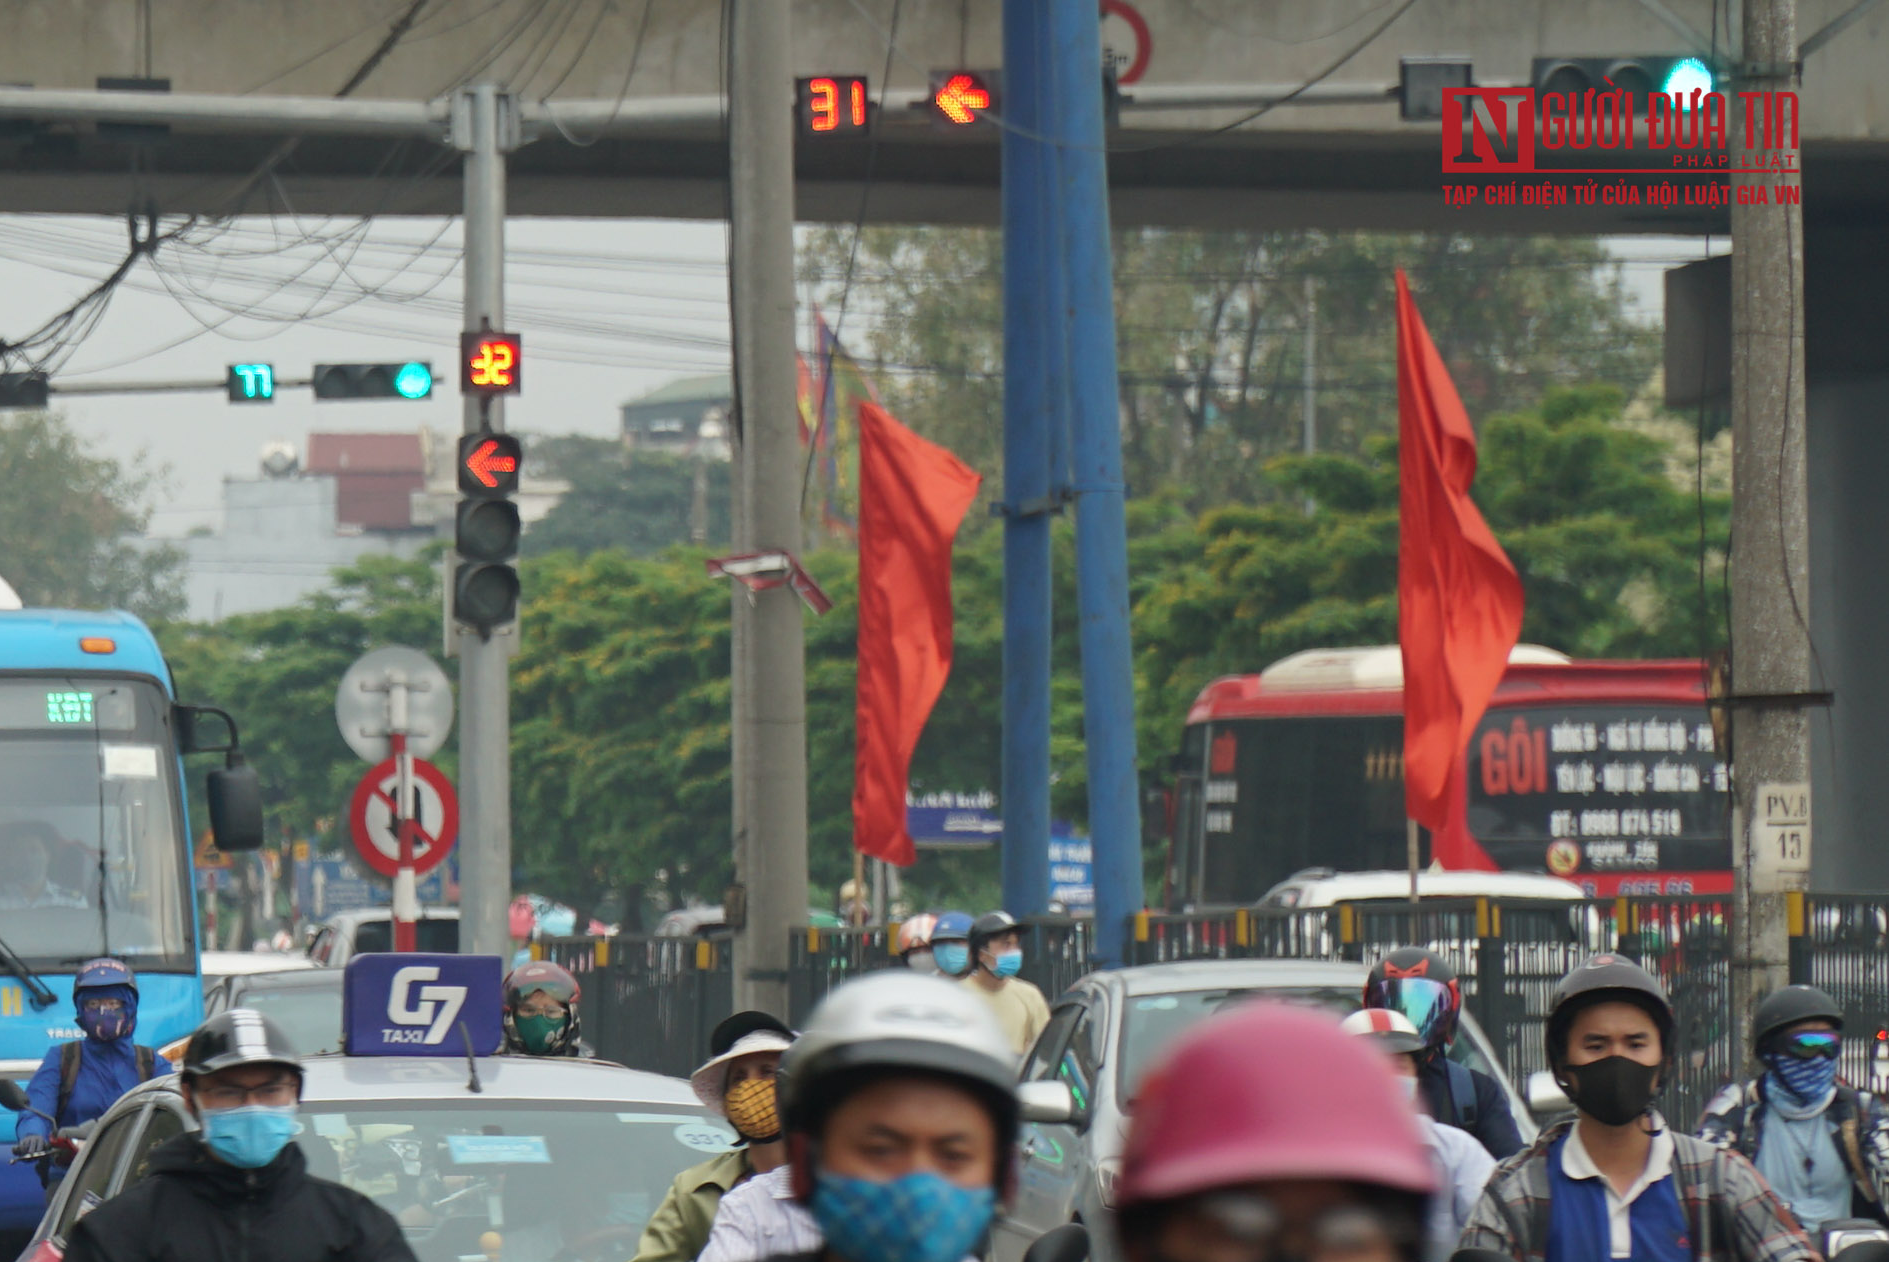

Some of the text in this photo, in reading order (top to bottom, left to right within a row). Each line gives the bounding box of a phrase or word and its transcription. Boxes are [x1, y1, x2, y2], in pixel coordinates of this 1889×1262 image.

[810, 78, 865, 131] 31
[235, 364, 272, 398] 77
[1480, 716, 1548, 796] GÔI
[1777, 832, 1802, 859] 15
[387, 966, 468, 1045] G7
[381, 1029, 425, 1044] TAXI
